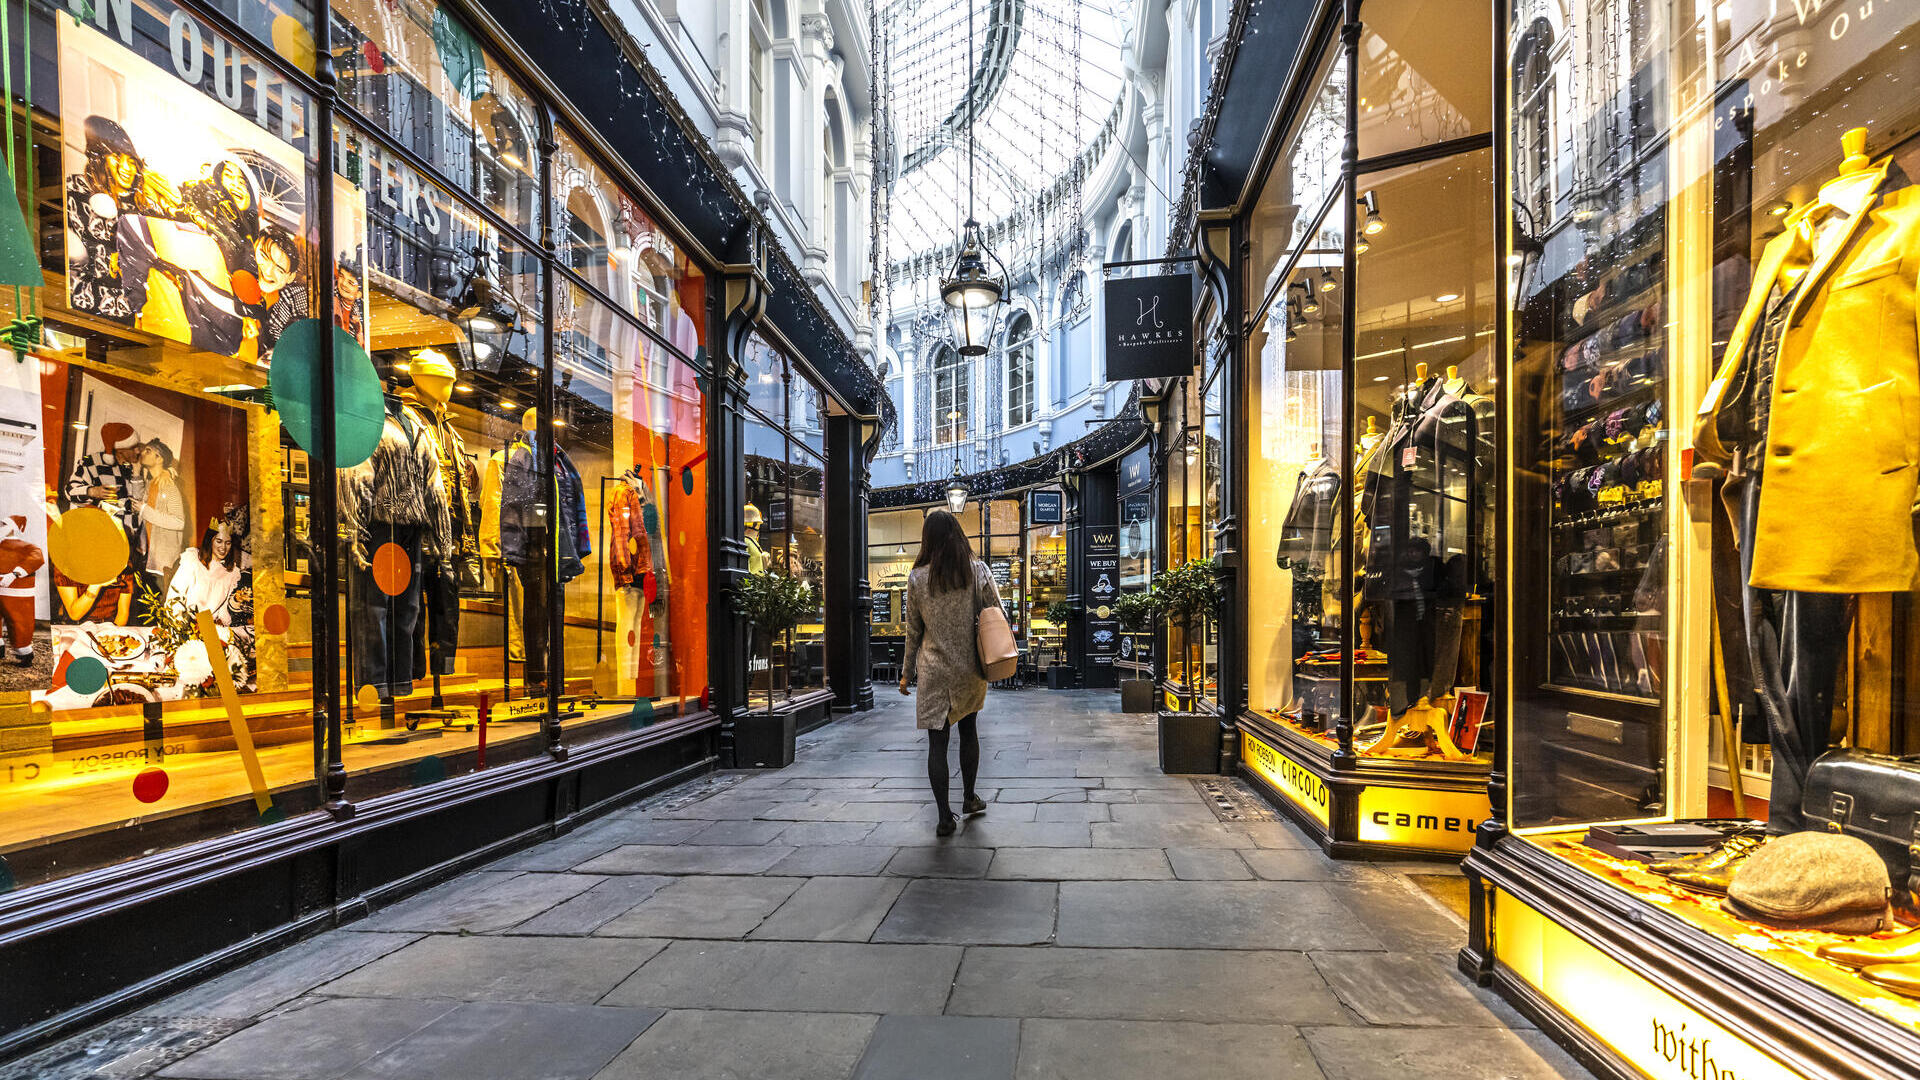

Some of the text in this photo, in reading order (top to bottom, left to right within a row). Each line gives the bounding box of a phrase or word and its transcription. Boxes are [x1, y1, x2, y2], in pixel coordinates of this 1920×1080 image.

[169, 8, 440, 234] OUTFITTERS
[1118, 330, 1183, 341] HAWKES
[1247, 738, 1276, 767] ROY ROBSON
[1282, 759, 1326, 807] CIRCOLO
